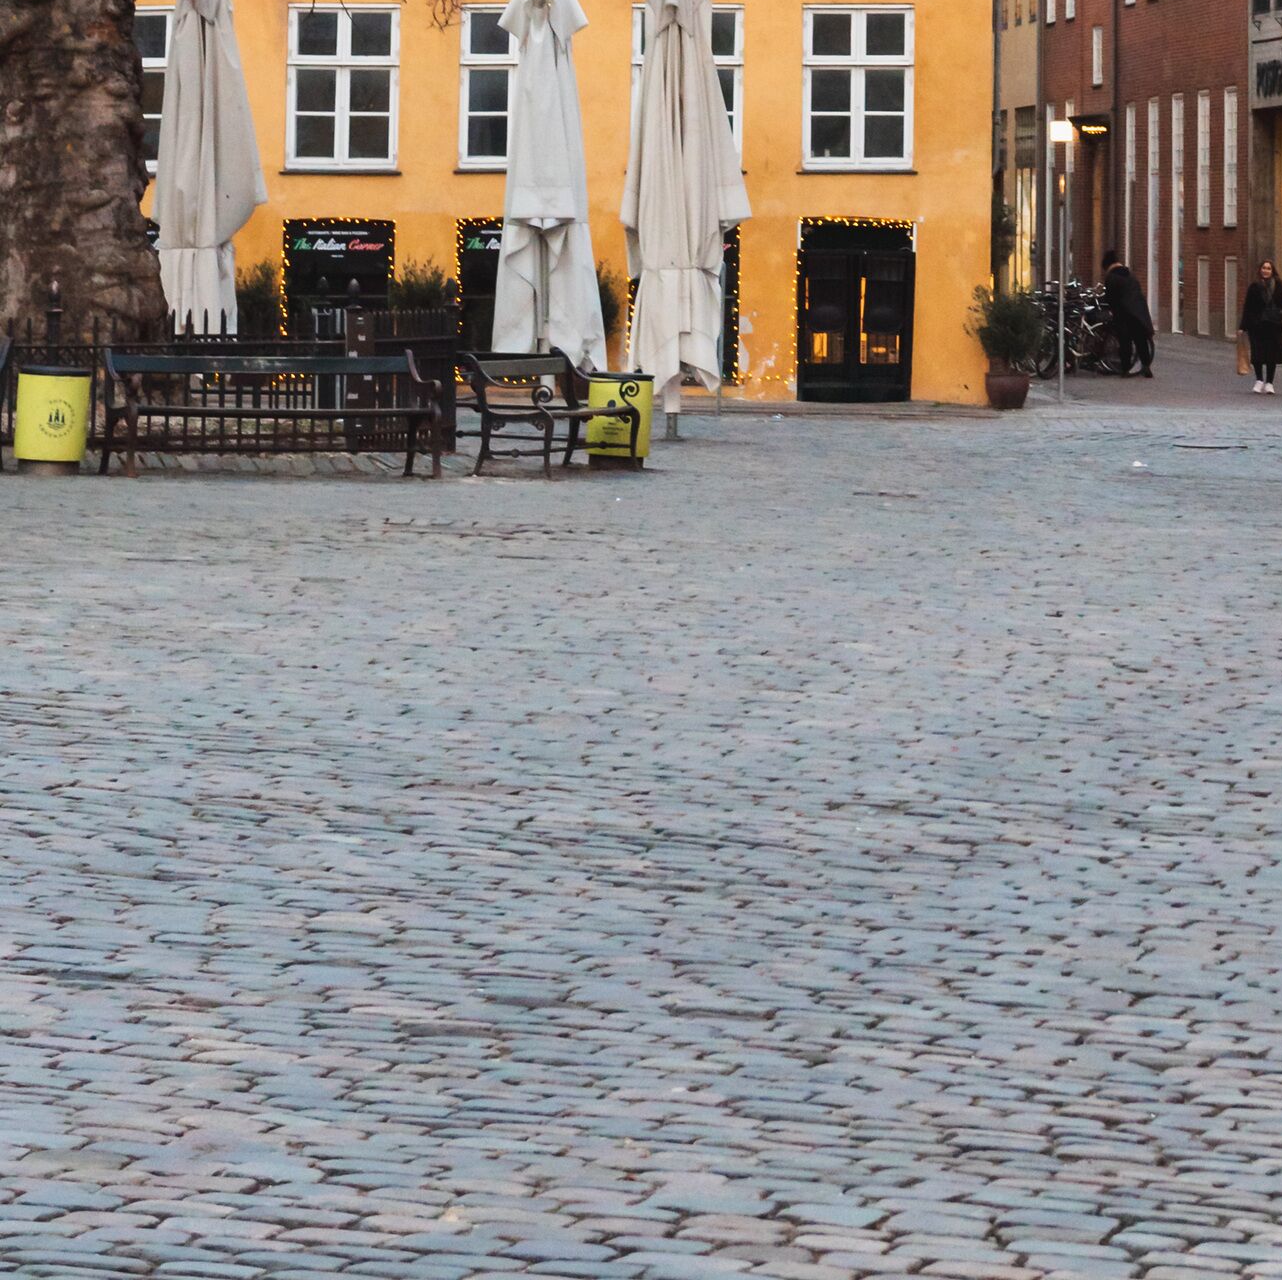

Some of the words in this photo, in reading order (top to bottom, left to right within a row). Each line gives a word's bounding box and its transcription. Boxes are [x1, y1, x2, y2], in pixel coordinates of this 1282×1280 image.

[294, 237, 312, 250] The
[313, 237, 347, 251] Italian
[348, 238, 385, 251] Corner
